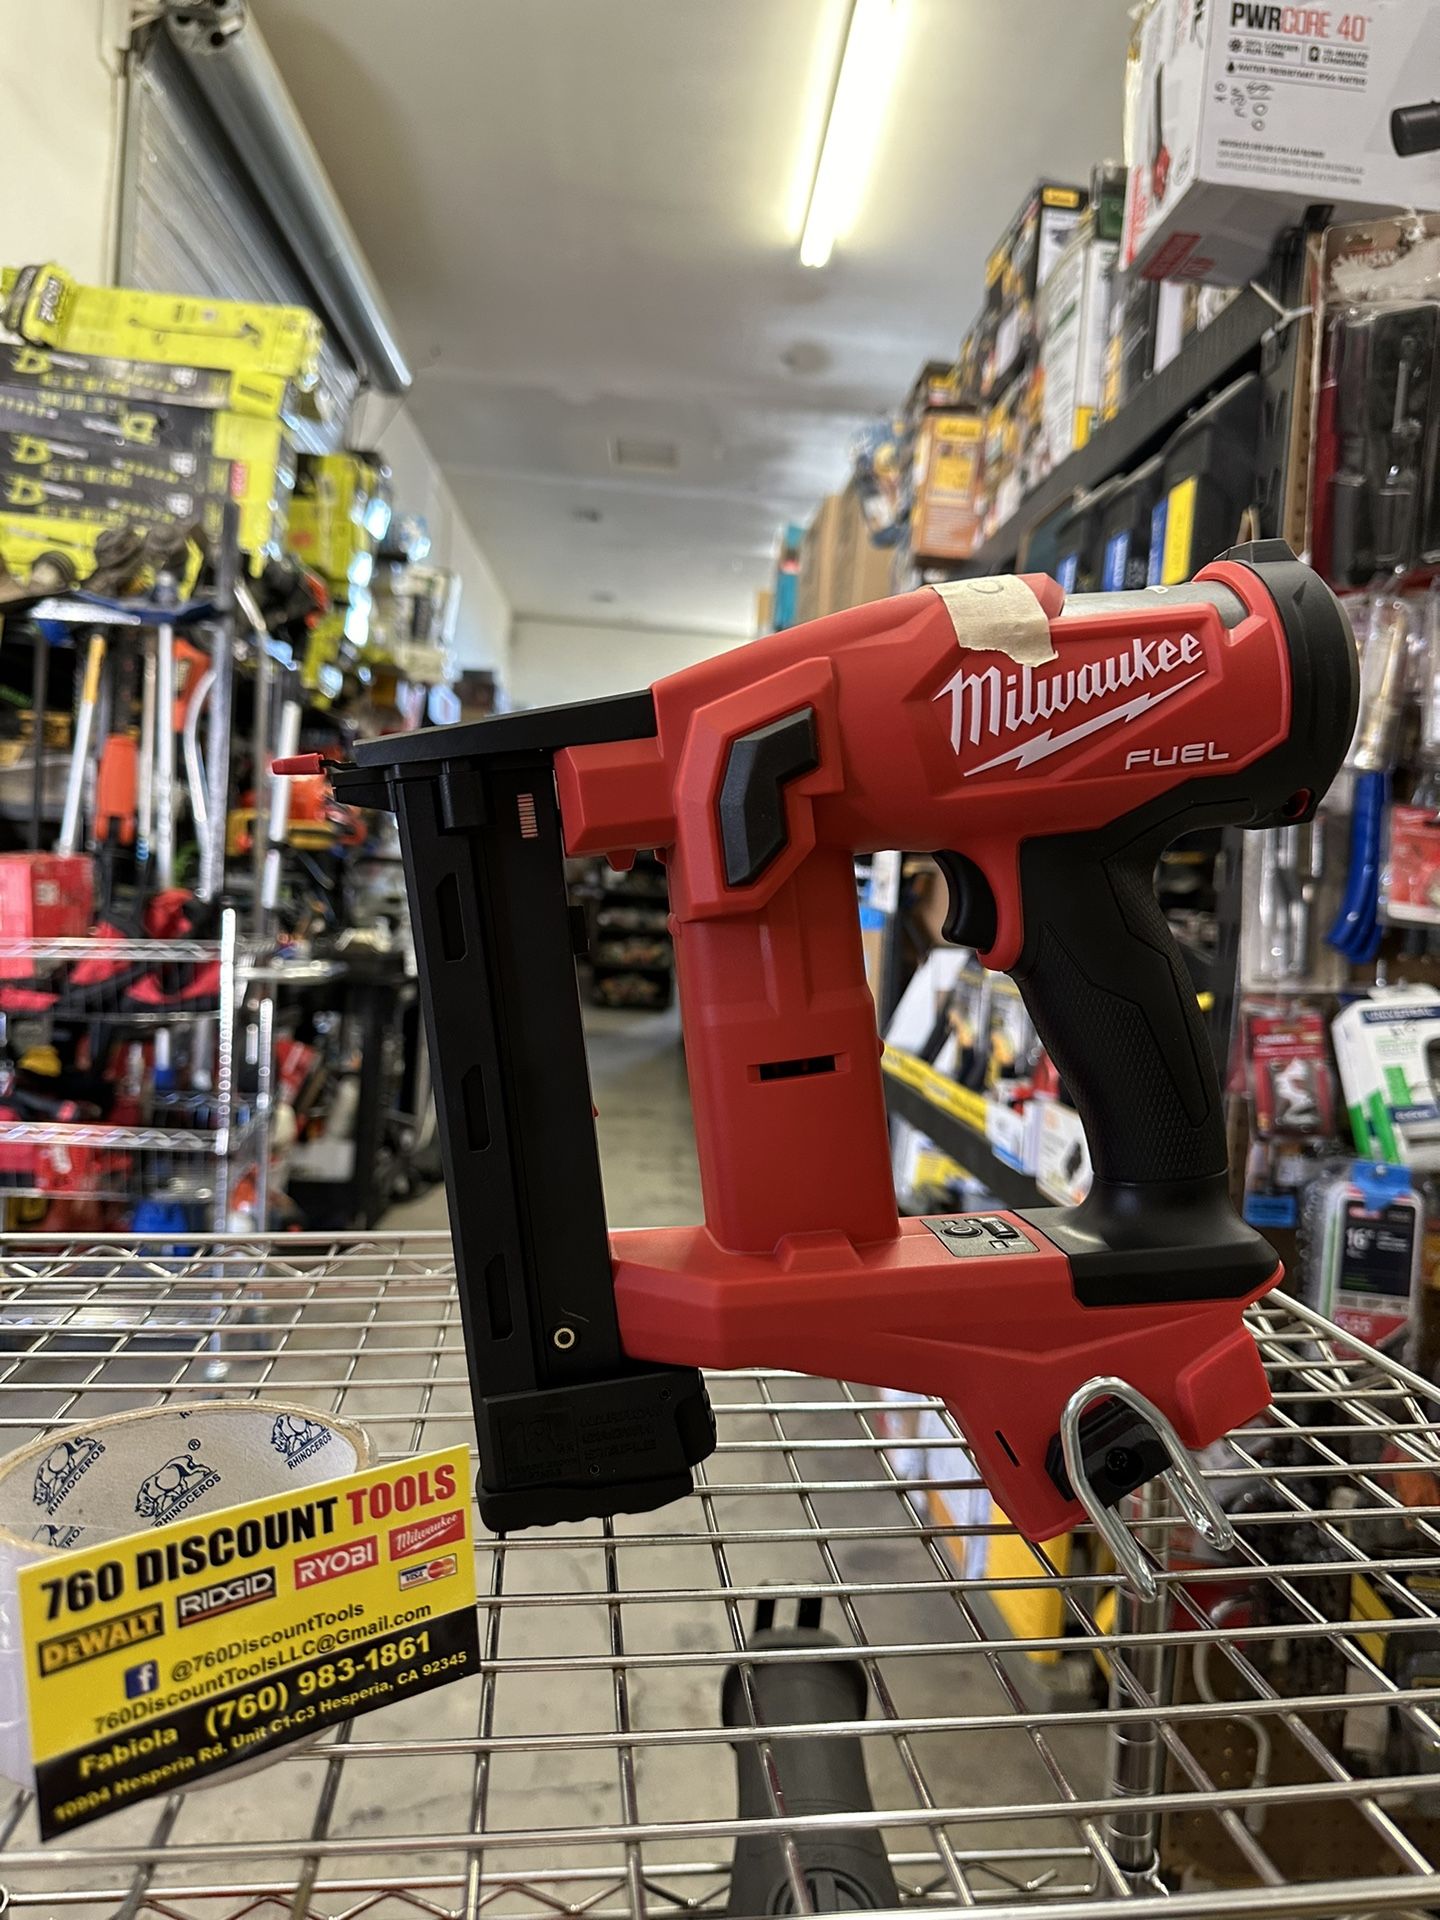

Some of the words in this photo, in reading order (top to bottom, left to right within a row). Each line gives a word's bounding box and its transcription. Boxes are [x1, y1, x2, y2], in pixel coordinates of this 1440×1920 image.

[1230, 2, 1330, 38] PWRCORE
[932, 632, 1203, 755] Milwaukee
[1125, 742, 1230, 770] FUEL
[47, 1444, 106, 1516] RHINOCEROS
[287, 1431, 333, 1470] RHINOCEROS
[40, 1560, 124, 1621] 760
[136, 1496, 338, 1591] DISCOUNT
[346, 1463, 457, 1526] TOOLS
[181, 1573, 273, 1618] RIDGID
[298, 1543, 373, 1583] RYOBI
[396, 1512, 457, 1552] Milwaukee
[94, 1605, 432, 1734] 760DiscountToolsLLC@Gmail.com
[172, 1604, 364, 1682] @760DiscountTools
[79, 1727, 179, 1779] Fabiola
[205, 1682, 289, 1738] (760)
[298, 1631, 431, 1697] 983-1861
[113, 1756, 195, 1796] Hesperia
[231, 1727, 267, 1749] Unit
[270, 1704, 316, 1733] C1-C3
[319, 1681, 394, 1714] Hesperia,
[396, 1669, 420, 1686] CA
[421, 1651, 468, 1677] 92345
